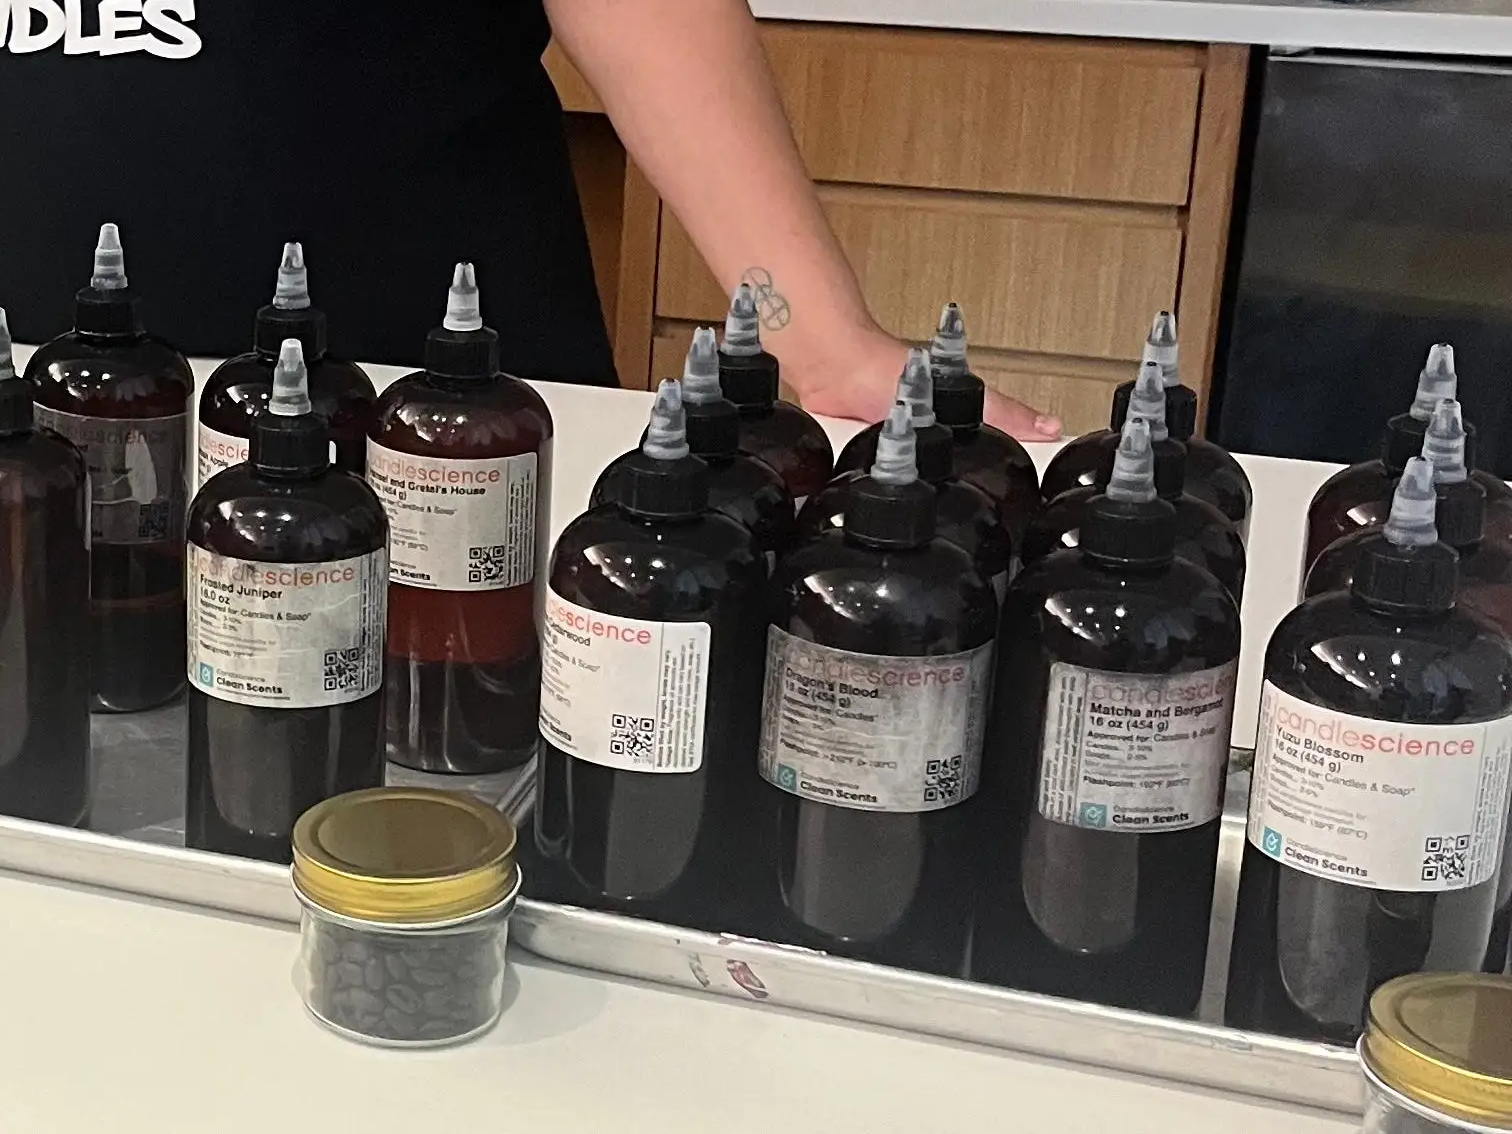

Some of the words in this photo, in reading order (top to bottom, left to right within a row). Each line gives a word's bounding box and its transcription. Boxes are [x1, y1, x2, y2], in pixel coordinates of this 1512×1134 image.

[451, 485, 486, 495] House
[200, 573, 233, 594] Frosted
[237, 585, 282, 600] Juniper
[218, 595, 230, 605] oz
[216, 677, 245, 692] Clean
[246, 682, 283, 694] Scents
[839, 682, 879, 699] Blood
[1090, 703, 1141, 718] Matcha
[1145, 706, 1170, 718] and
[1090, 716, 1103, 726] 16
[1108, 720, 1123, 728] oz
[1126, 718, 1153, 731] (454
[1157, 720, 1169, 732] g)
[1276, 705, 1475, 756] candlescience
[1276, 724, 1301, 745] Yuzu
[1304, 739, 1364, 764] Blossom
[1287, 747, 1298, 758] oz
[1300, 750, 1325, 767] (454
[1328, 759, 1341, 773] g)
[800, 780, 834, 797] Clean
[836, 789, 877, 803] Scents
[1112, 814, 1150, 824] Clean
[1153, 812, 1189, 823] Scents
[1284, 846, 1320, 866] Clean
[1321, 858, 1368, 876] Scents
